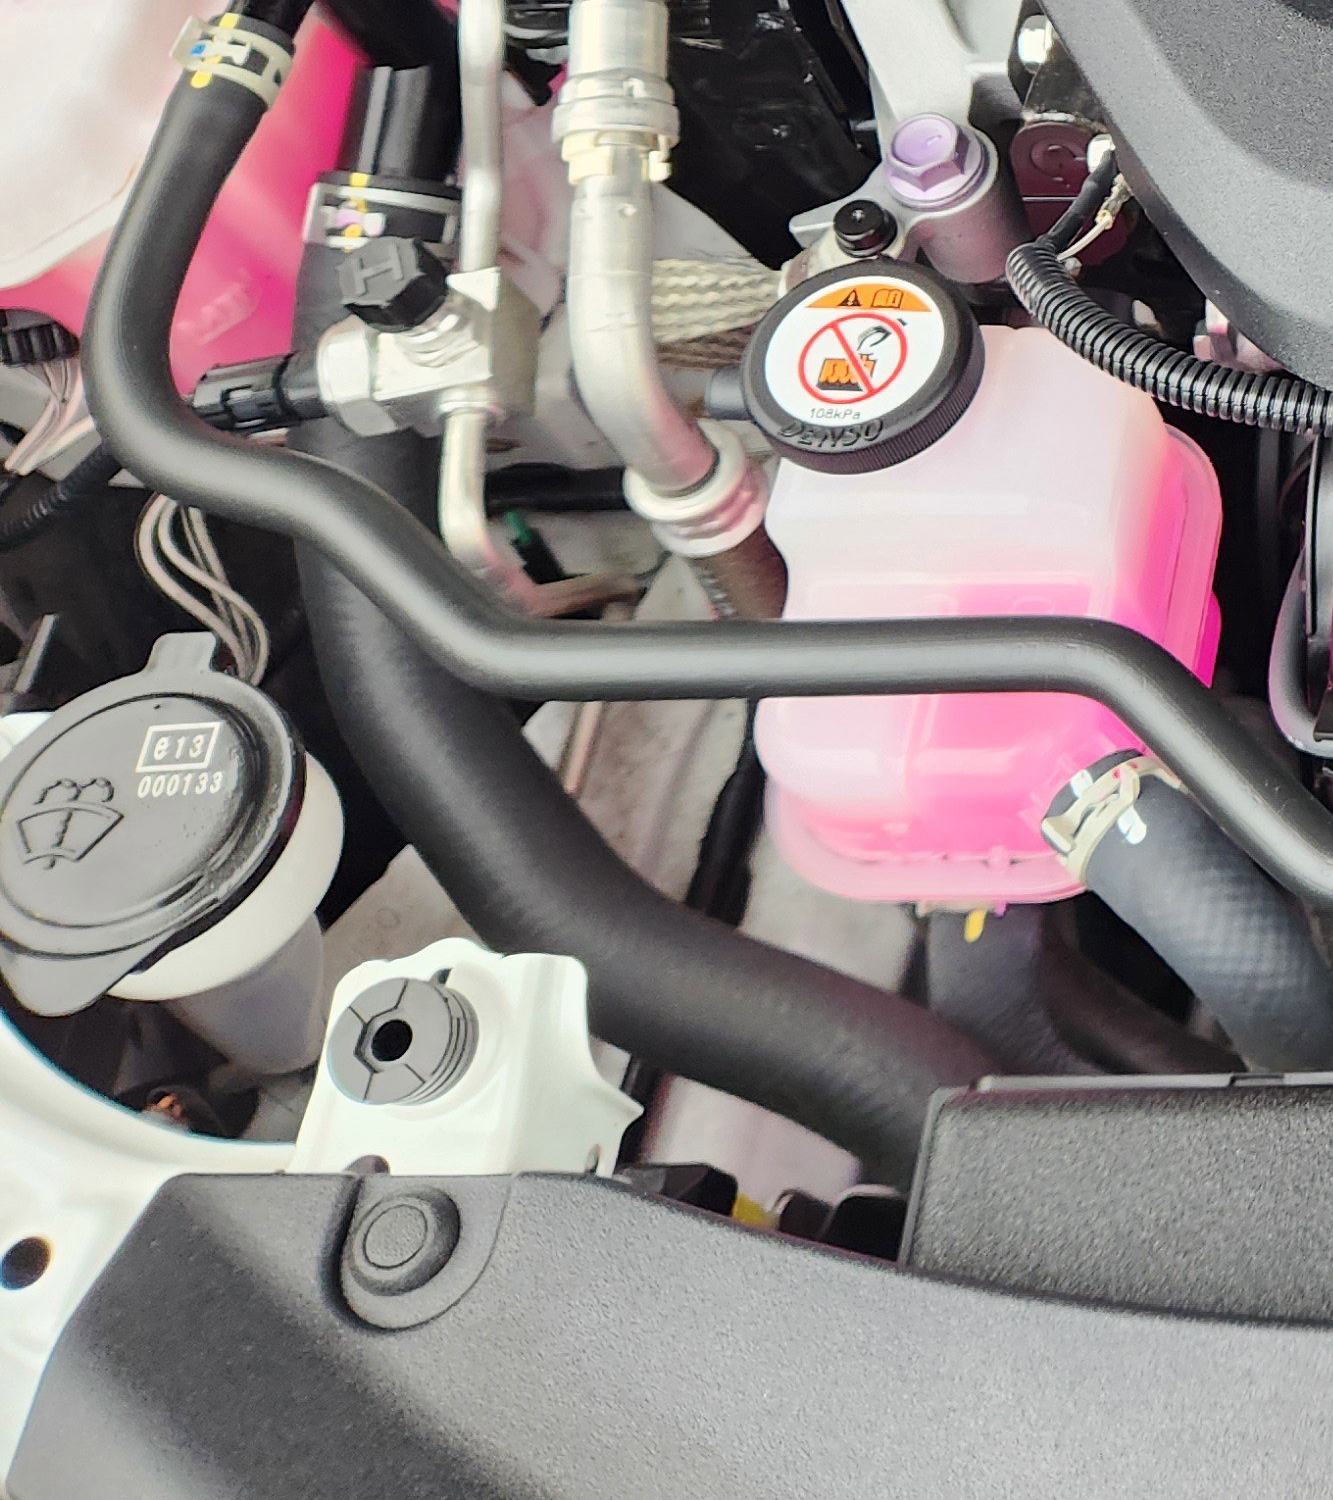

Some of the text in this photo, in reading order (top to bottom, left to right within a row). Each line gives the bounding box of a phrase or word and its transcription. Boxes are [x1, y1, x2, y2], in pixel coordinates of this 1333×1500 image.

[810, 407, 861, 420] 108kPa
[778, 419, 884, 448] DENSO
[153, 734, 205, 761] e13
[136, 771, 223, 799] 000133
